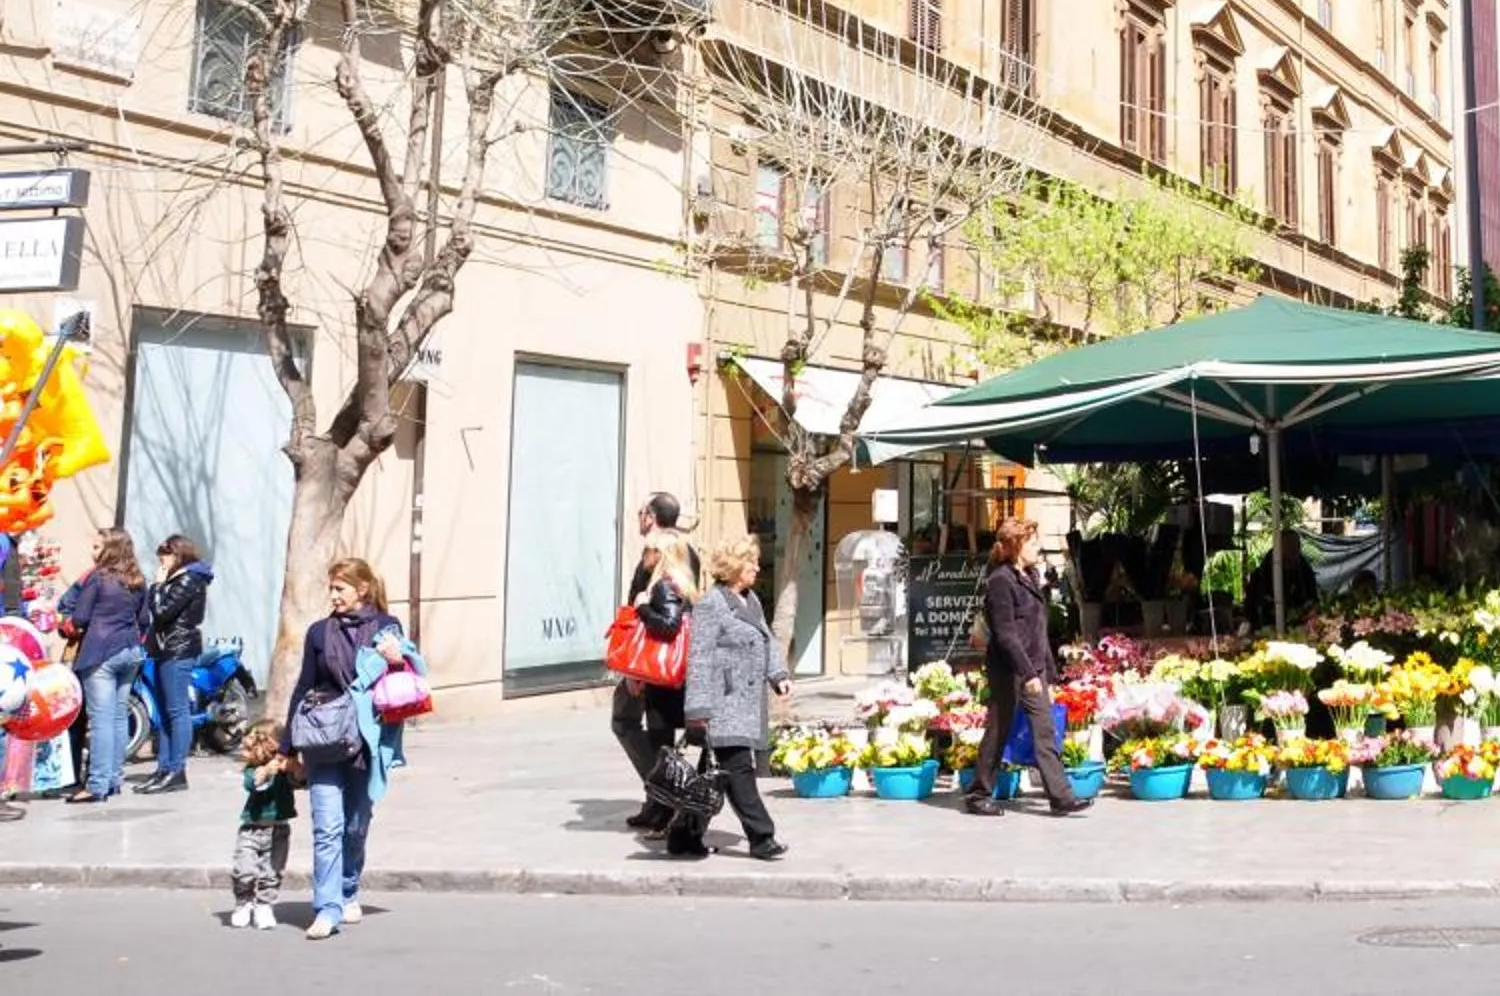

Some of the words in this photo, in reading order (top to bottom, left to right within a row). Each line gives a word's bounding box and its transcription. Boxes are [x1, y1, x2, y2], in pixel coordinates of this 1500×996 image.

[4, 239, 58, 259] ELLA
[915, 611, 925, 624] A
[928, 611, 974, 624] DOMIC
